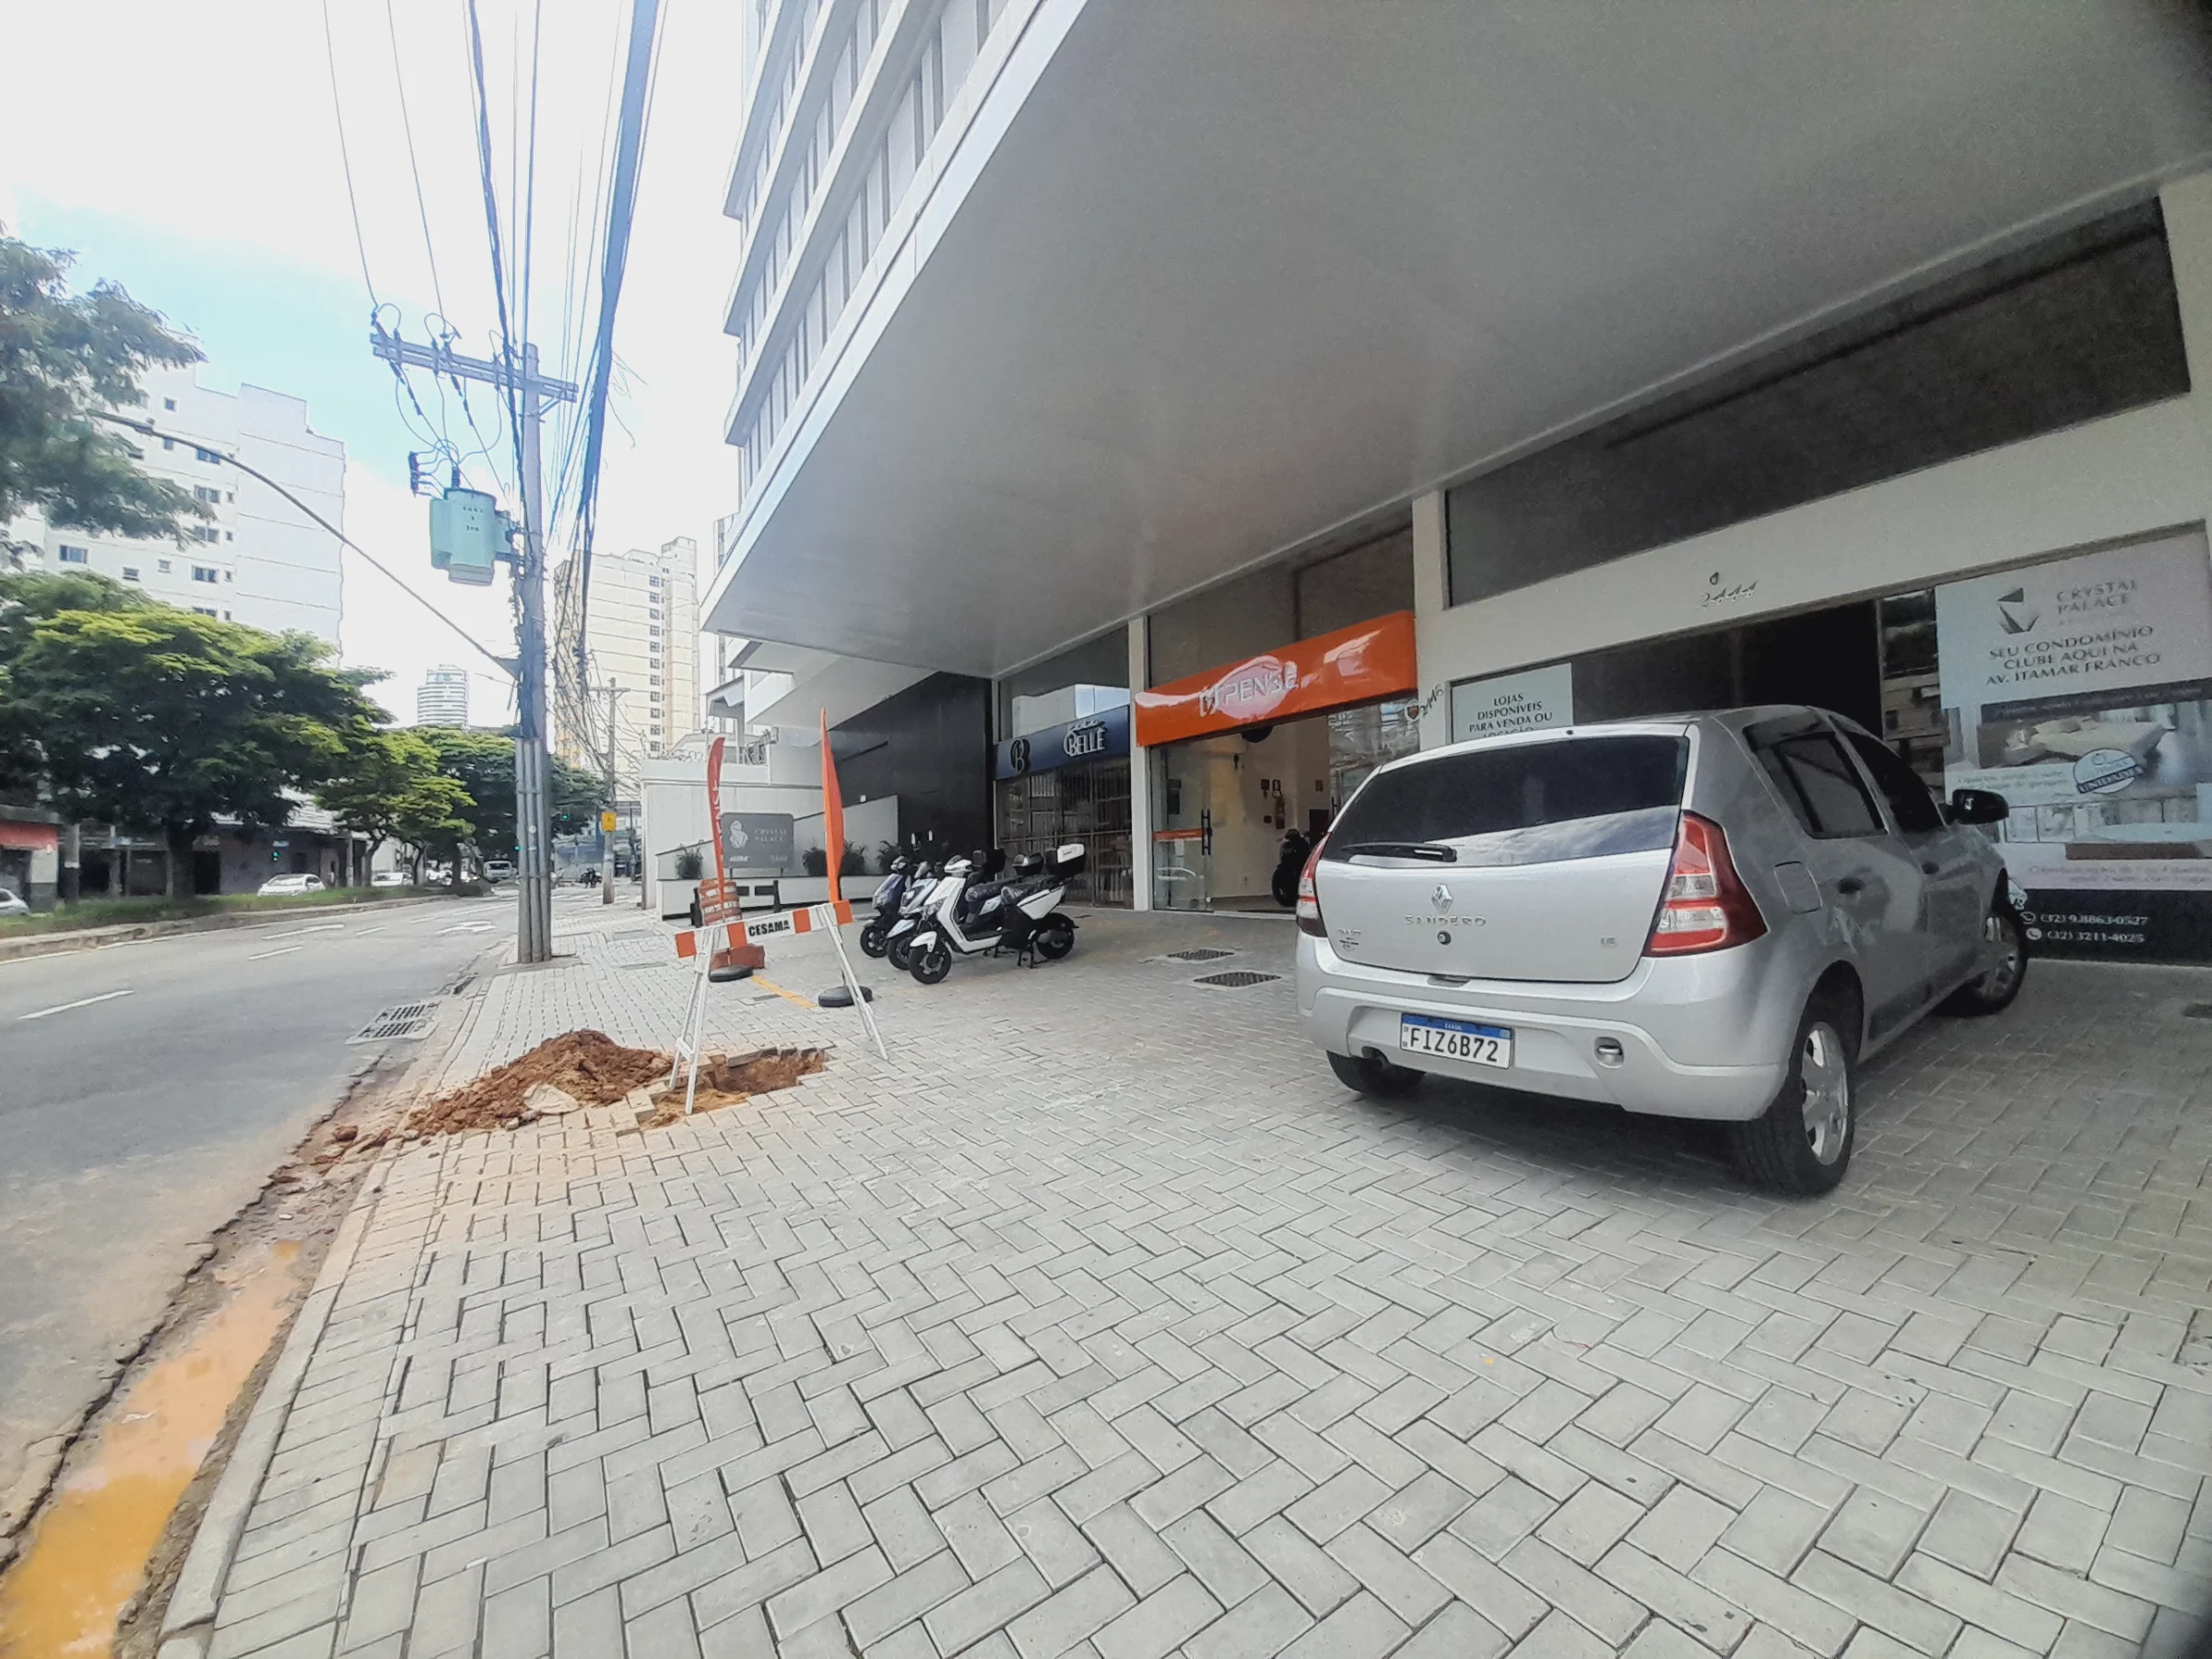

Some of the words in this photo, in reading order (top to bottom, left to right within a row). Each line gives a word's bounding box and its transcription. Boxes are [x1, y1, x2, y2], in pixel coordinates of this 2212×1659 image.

[2057, 593, 2131, 615] PALACE
[1989, 646, 2019, 659] SEU
[2004, 655, 2055, 670] CLUBE
[2112, 643, 2138, 653] NA
[2015, 663, 2079, 682] ITAMAR
[2085, 653, 2161, 673] FRANCO
[1493, 692, 1524, 707] LOJAS
[1477, 700, 1543, 721] DISPONÍVEIS
[1469, 723, 1493, 733] PARA
[1496, 715, 1532, 728] VENDA
[1534, 712, 1553, 724] OU
[748, 920, 791, 937] CESAMA
[1404, 915, 1487, 926] SANDERO
[1410, 1028, 1499, 1063] FIZ6B72
